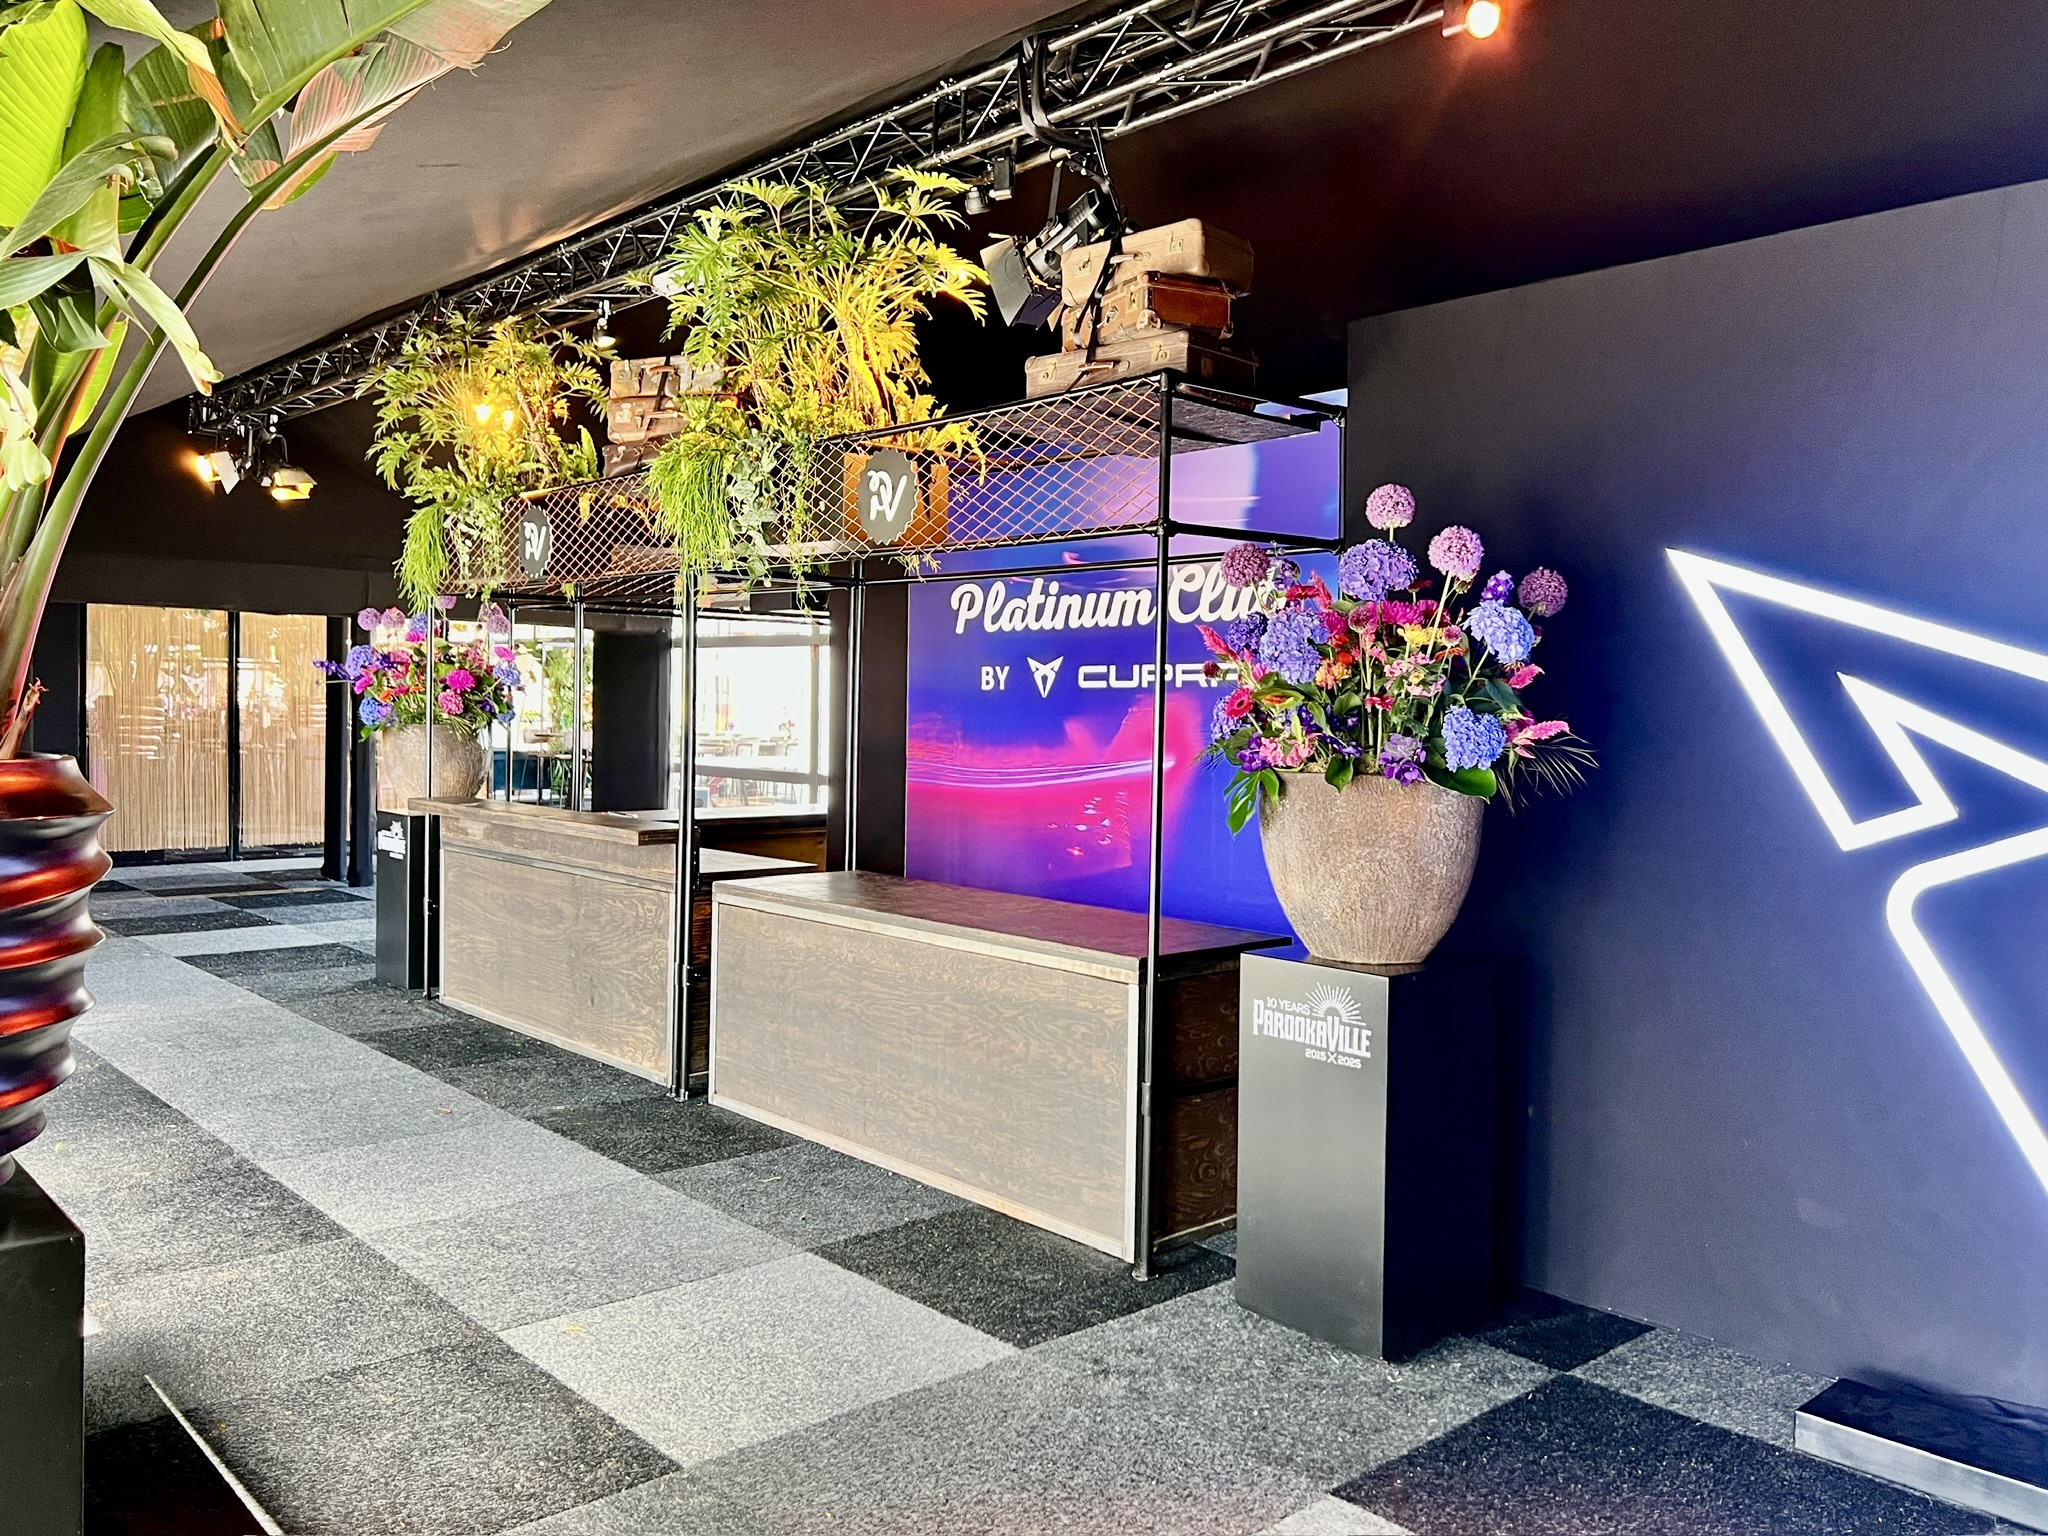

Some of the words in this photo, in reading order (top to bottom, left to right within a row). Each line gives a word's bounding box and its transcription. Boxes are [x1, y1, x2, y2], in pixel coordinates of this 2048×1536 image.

[950, 577, 1157, 635] Platinum
[980, 665, 1010, 691] BY
[1266, 996, 1277, 1009] 10
[1278, 998, 1312, 1016] YEARS
